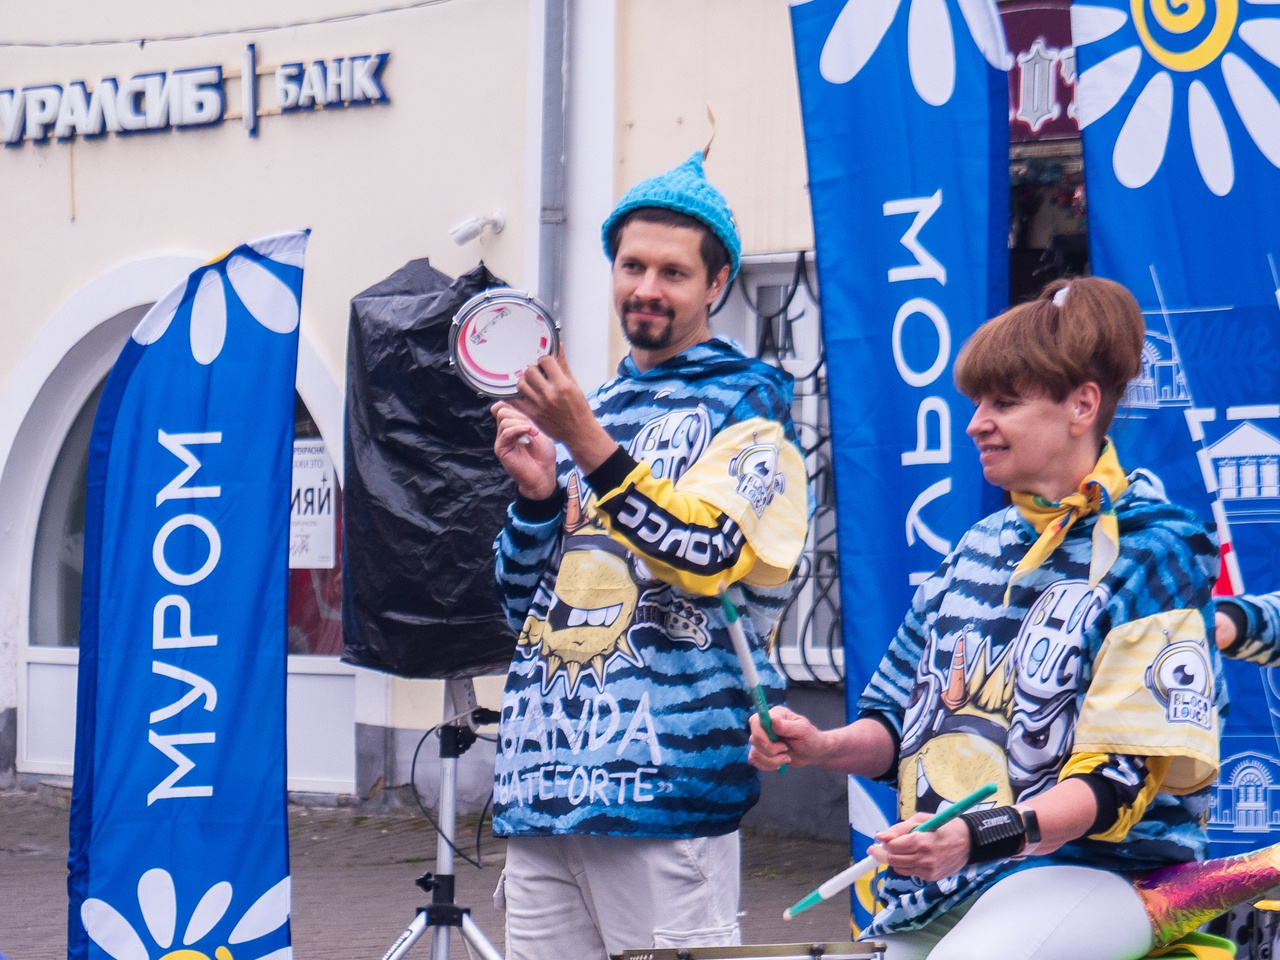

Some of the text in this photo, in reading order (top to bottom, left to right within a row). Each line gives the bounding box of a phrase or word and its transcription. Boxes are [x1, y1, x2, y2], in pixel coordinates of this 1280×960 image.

[274, 53, 390, 110] БАНК
[147, 428, 223, 807] МУРОМ
[1021, 633, 1081, 687] LOUC
[1173, 706, 1208, 725] LOUCO
[1174, 693, 1208, 713] BLOCO
